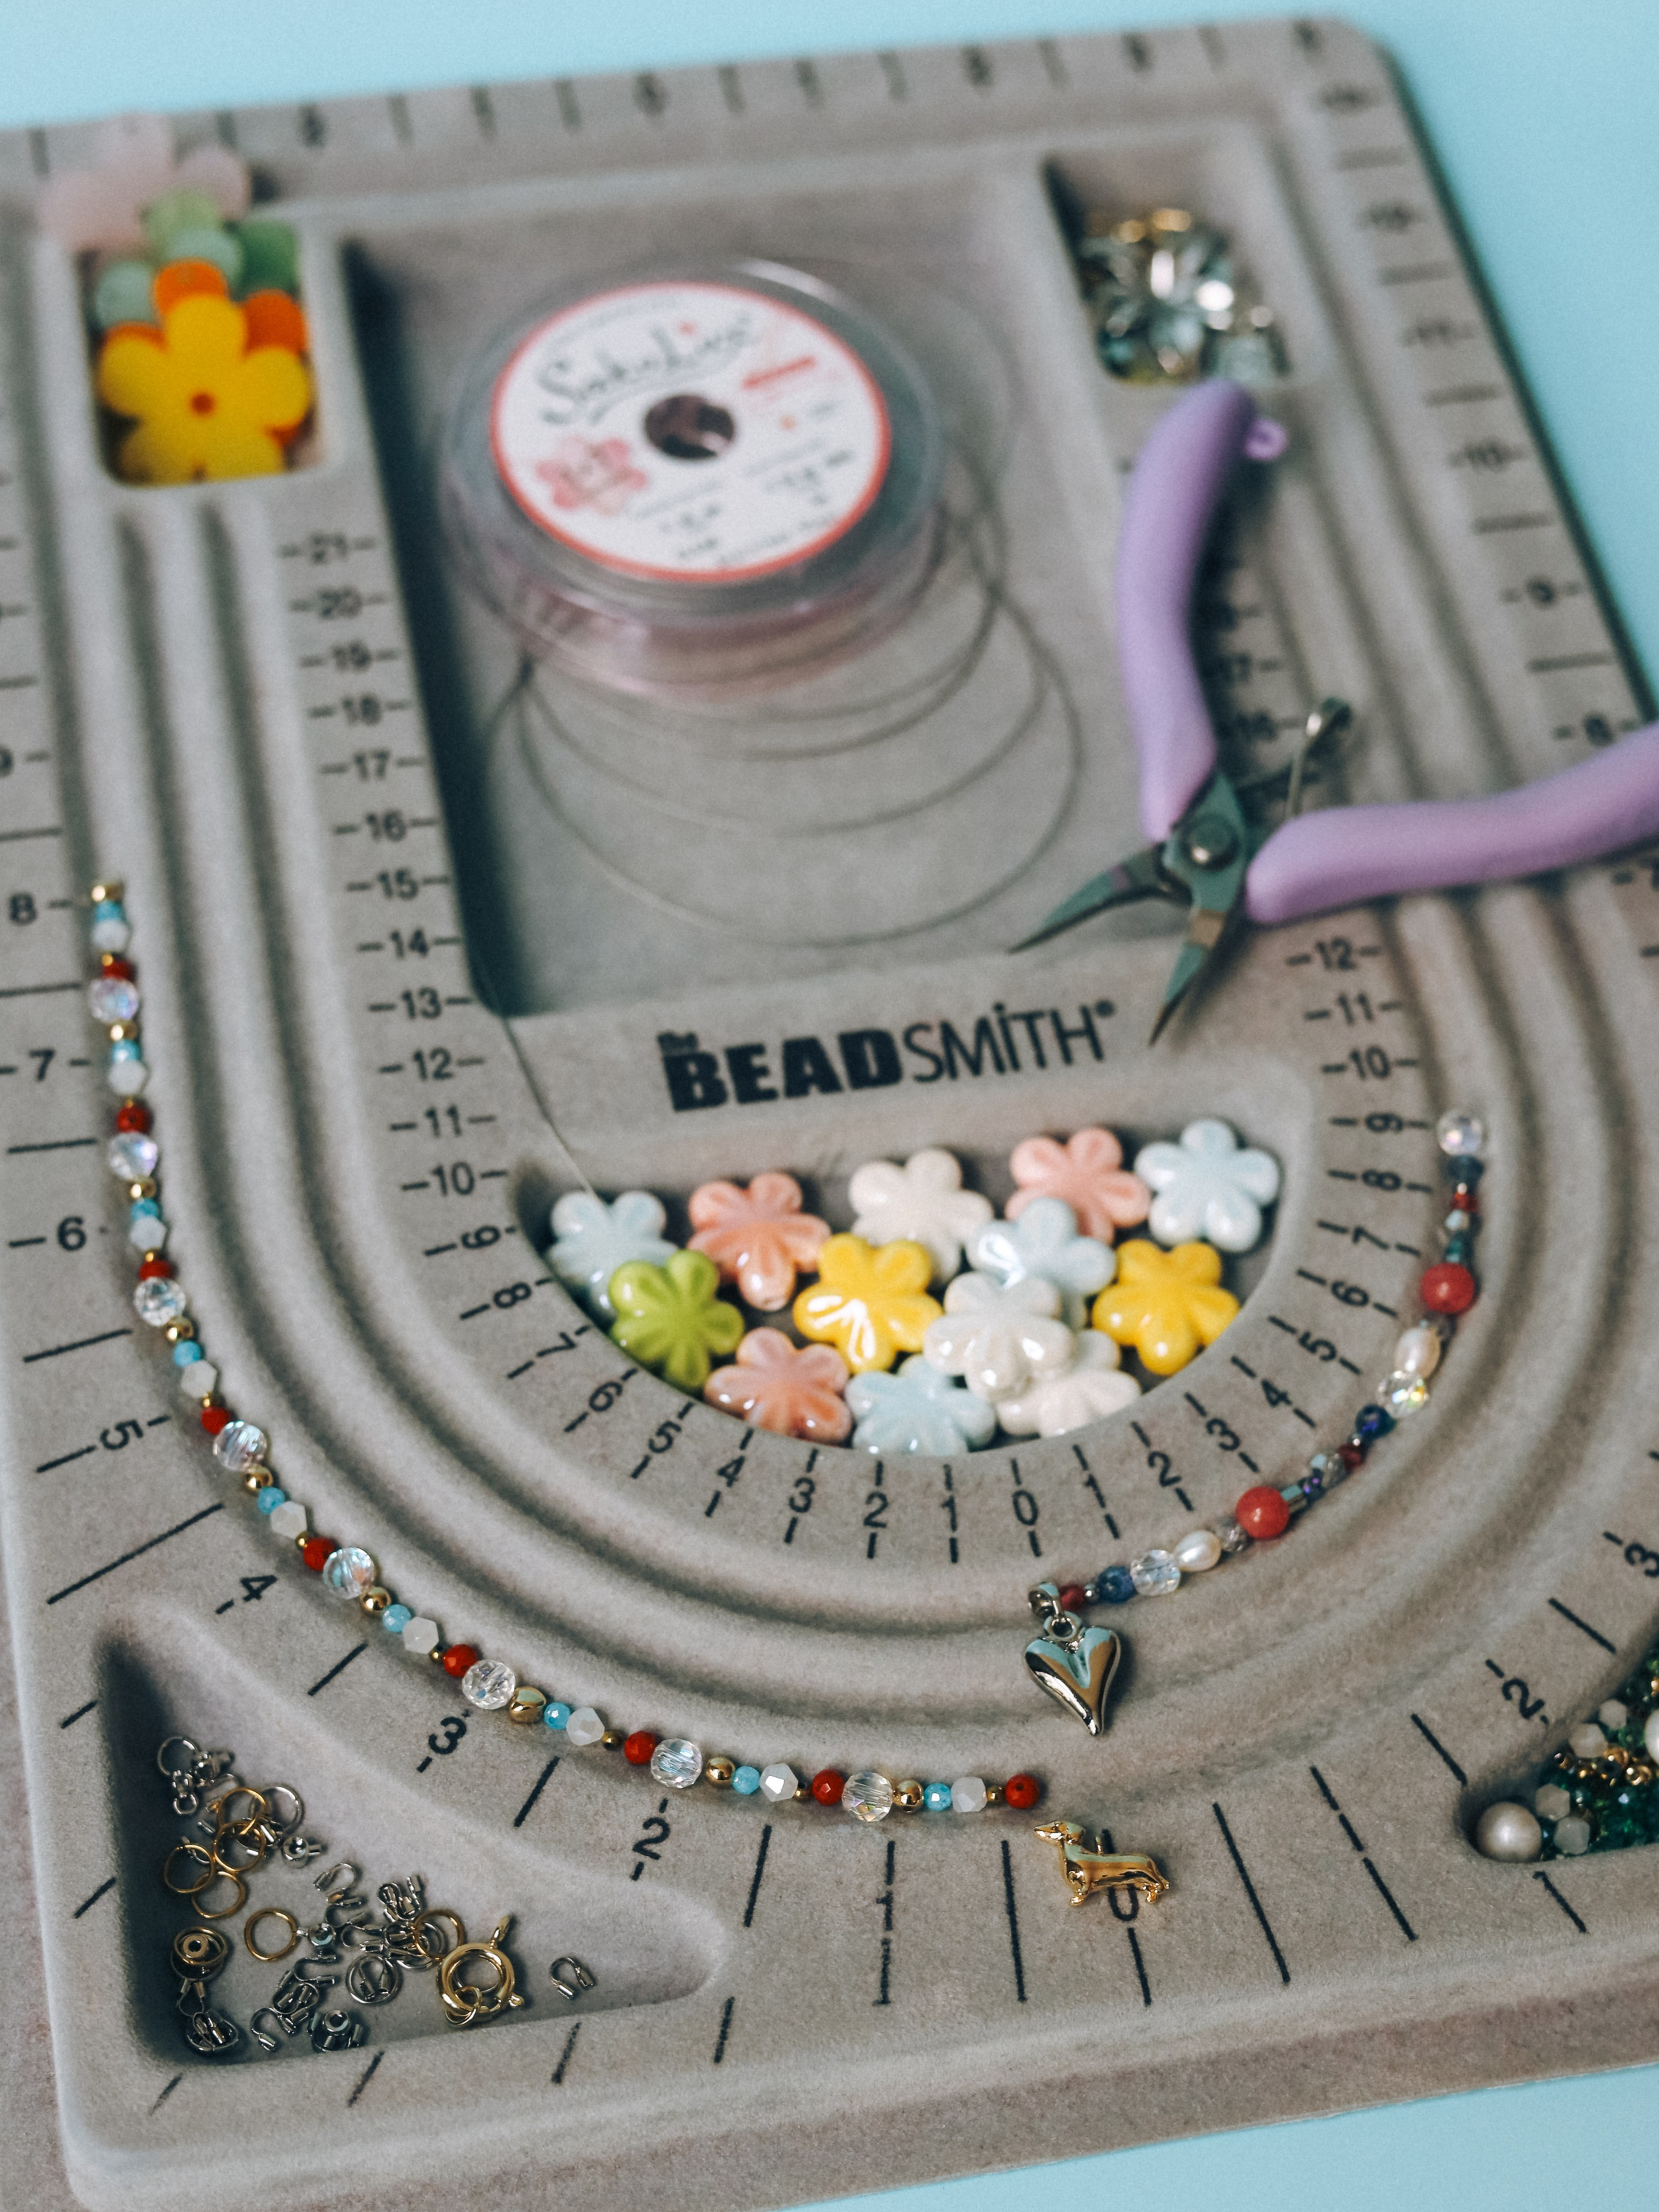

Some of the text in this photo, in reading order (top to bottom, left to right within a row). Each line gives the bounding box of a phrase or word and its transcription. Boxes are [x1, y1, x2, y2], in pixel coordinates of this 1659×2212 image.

[354, 749, 391, 780] 17
[366, 810, 407, 843] 16
[378, 867, 419, 900] 15
[9, 893, 37, 926] 8
[391, 928, 429, 960] 14
[1315, 938, 1356, 971] 12
[402, 986, 442, 1020] 13
[1338, 993, 1374, 1025] 11
[29, 1049, 56, 1082] 7
[413, 1047, 454, 1081] 12
[1349, 1046, 1390, 1080] 10
[425, 1104, 461, 1137] 11
[1364, 1113, 1403, 1133] 9
[432, 1161, 474, 1196] 10
[1362, 1170, 1401, 1191] 8
[56, 1216, 86, 1251] 6
[461, 1225, 500, 1249] 9
[1351, 1226, 1390, 1251] 7
[492, 1282, 531, 1309] 8
[1331, 1280, 1369, 1307] 6
[537, 1332, 577, 1357] 7
[1298, 1329, 1337, 1362] 5
[588, 1381, 623, 1413] 6
[1261, 1378, 1292, 1409] 4
[100, 1419, 144, 1451] 5
[648, 1421, 682, 1453] 5
[1205, 1417, 1241, 1452] 3
[717, 1455, 744, 1487] 4
[1148, 1450, 1181, 1487] 2
[789, 1477, 815, 1513] 3
[1011, 1490, 1038, 1526] 0
[1084, 1474, 1104, 1509] 1
[864, 1492, 888, 1528] 2
[941, 1496, 958, 1531] 1
[1625, 1542, 1659, 1578] 3
[240, 1575, 277, 1603] 4
[1501, 1677, 1545, 1719] 2
[428, 1716, 467, 1755] 3
[632, 1817, 670, 1860] 2
[876, 1890, 893, 1931] 1
